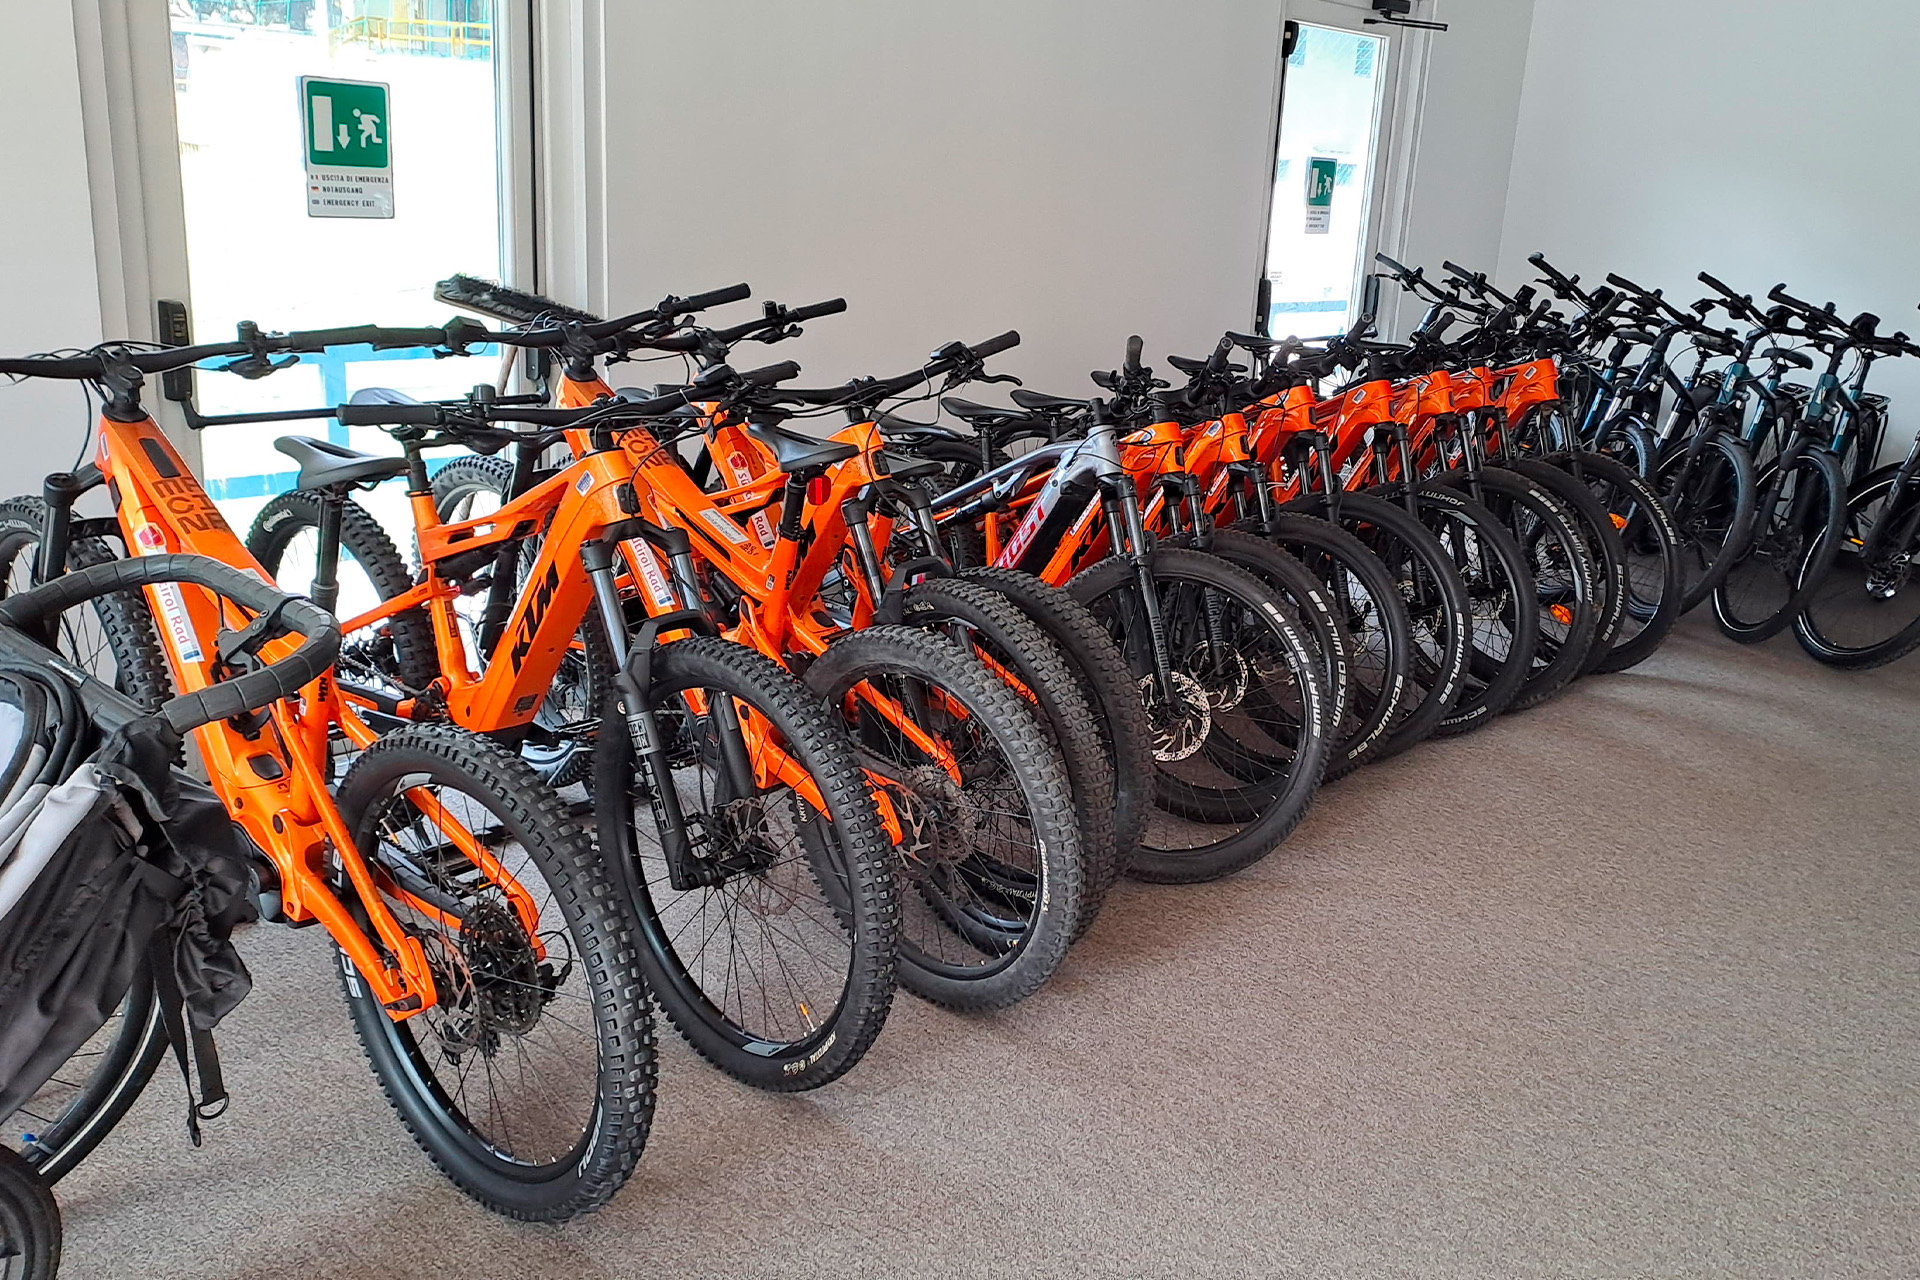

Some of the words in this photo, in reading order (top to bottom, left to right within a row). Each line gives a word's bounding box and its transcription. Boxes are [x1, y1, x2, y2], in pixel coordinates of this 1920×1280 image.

[1630, 479, 1677, 545] SCHWALBE
[646, 569, 664, 593] Rad
[1601, 563, 1624, 642] SCHWALBE
[170, 614, 191, 645] Rad
[510, 558, 560, 679] KTM
[1283, 626, 1310, 664] SAM
[1326, 615, 1345, 657] WILL
[1438, 612, 1465, 704] SCHWALBE
[1306, 670, 1322, 739] SMART
[1331, 661, 1347, 728] WICKED
[1346, 673, 1404, 761] SCHWALBE
